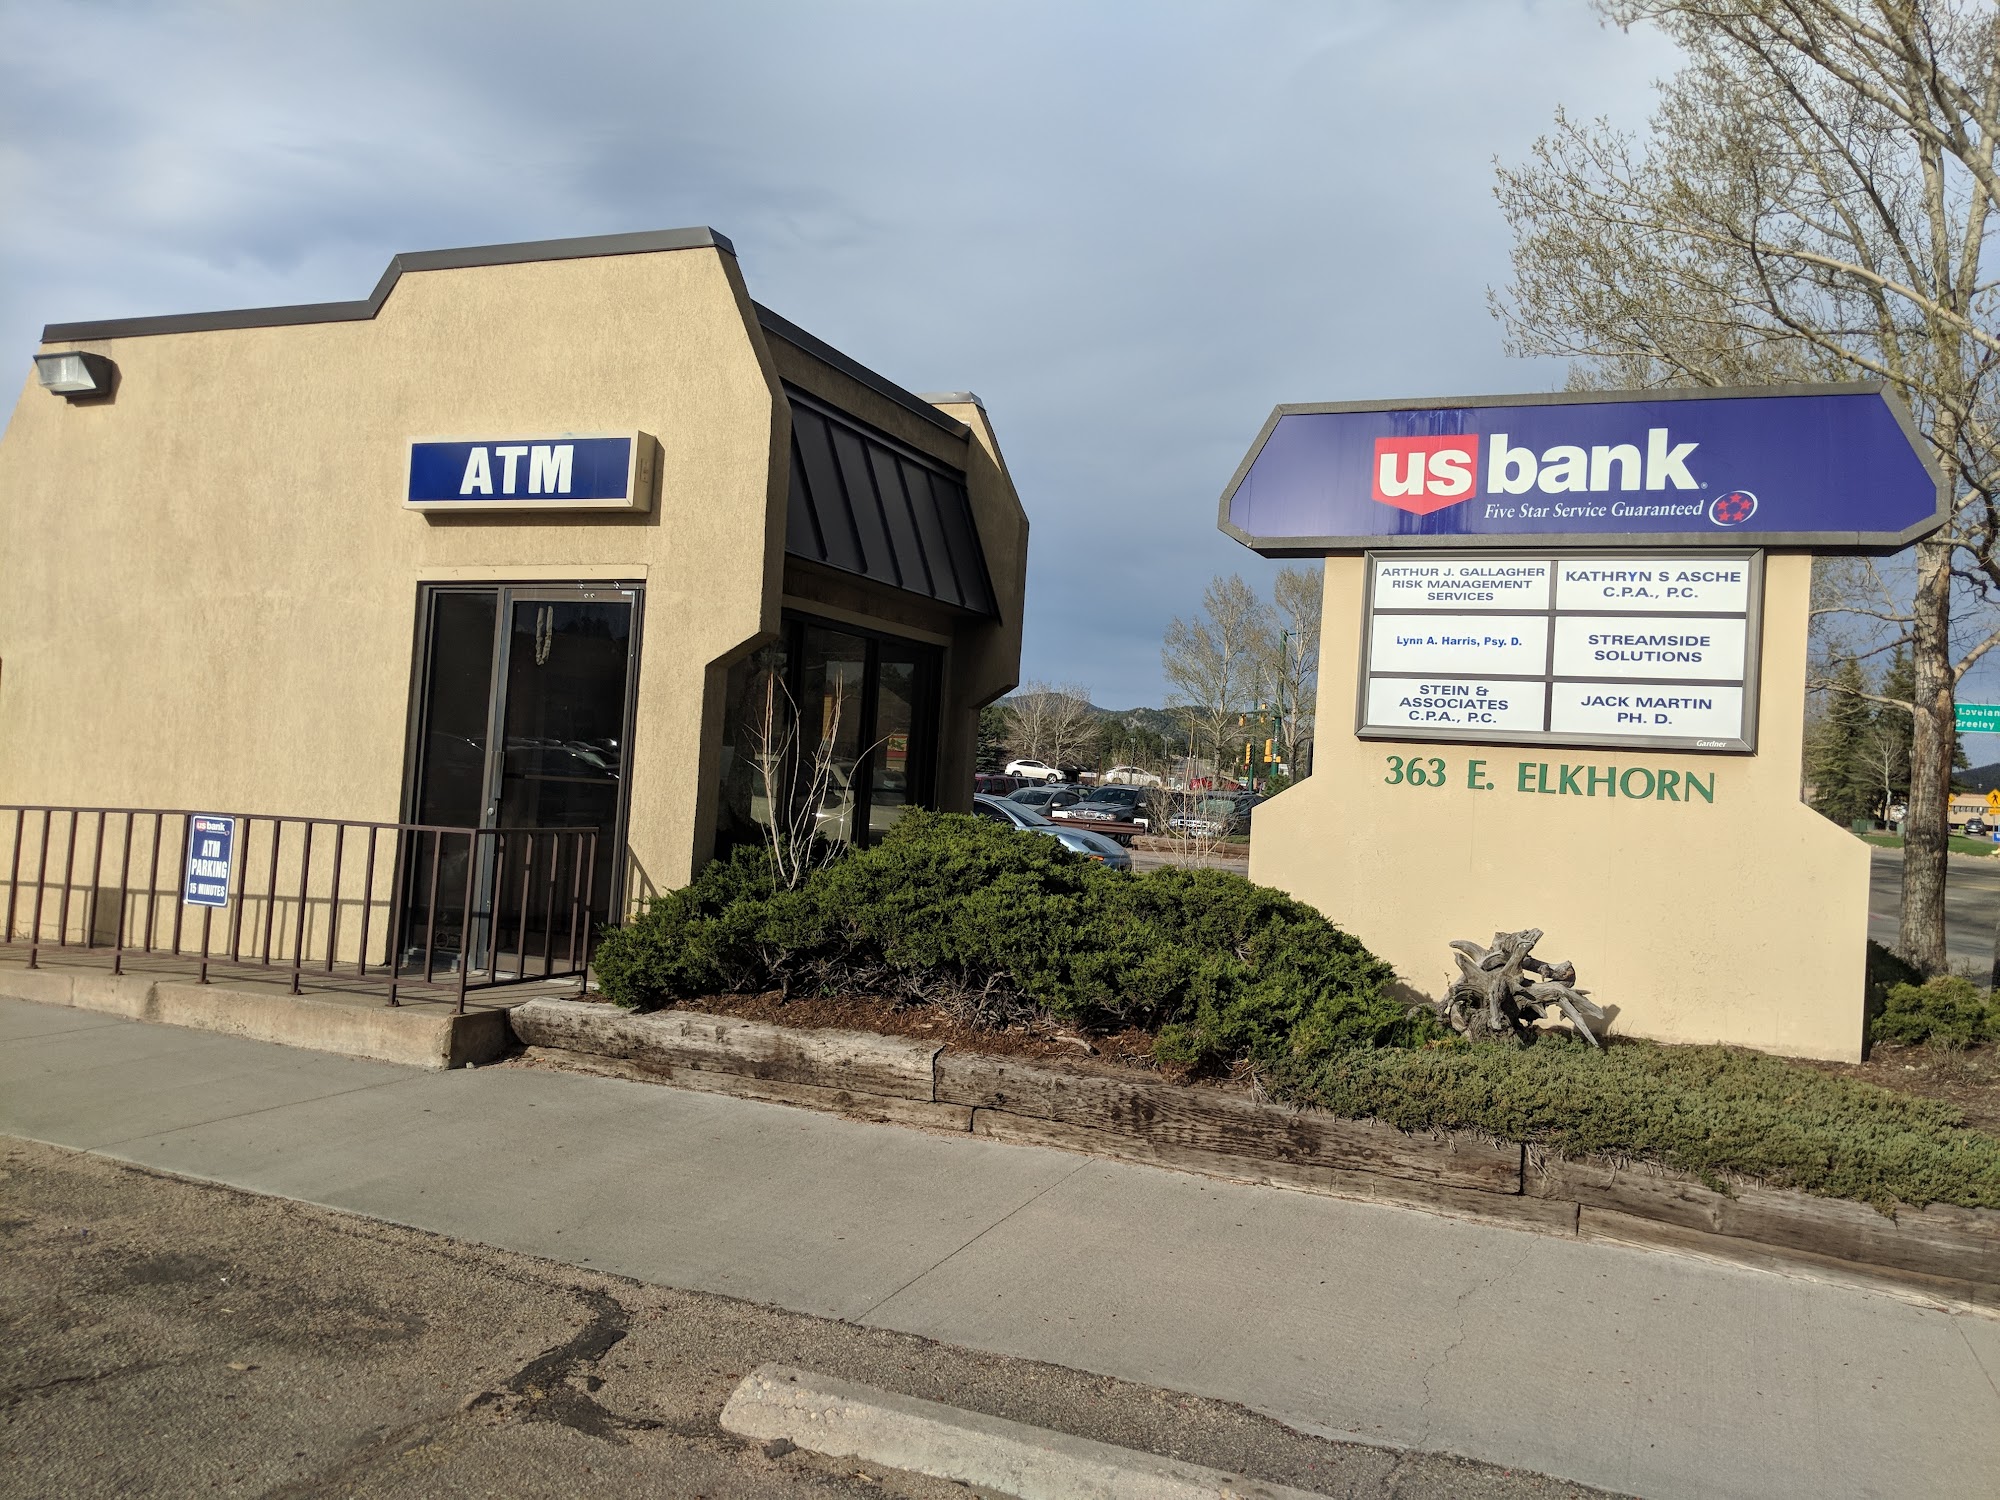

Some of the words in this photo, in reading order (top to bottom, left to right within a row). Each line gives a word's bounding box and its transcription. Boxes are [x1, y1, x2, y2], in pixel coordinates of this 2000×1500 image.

[1379, 449, 1473, 497] us
[1487, 428, 1700, 495] bank
[459, 444, 574, 495] ATM
[1484, 503, 1515, 518] Five
[1518, 502, 1551, 518] Star
[1553, 502, 1607, 517] Service
[1611, 499, 1704, 517] Guaranteed
[1381, 568, 1439, 577] ARTHUR
[1443, 568, 1454, 577] J.
[1459, 568, 1546, 577] GALLAGHER
[1565, 571, 1652, 582] KATHRYN
[1658, 571, 1670, 582] S
[1675, 571, 1741, 582] ASCHE
[1392, 580, 1424, 589] RISK
[1427, 580, 1533, 589] MANAGEMENT
[1427, 592, 1494, 601] SERVICES
[1603, 586, 1660, 600] C.P.A.,
[1666, 587, 1699, 599] P.C.
[1396, 635, 1423, 646] Lynn
[1426, 636, 1438, 645] A.
[1441, 637, 1480, 648] Harris,
[1484, 637, 1507, 648] Psy.
[1511, 637, 1522, 646] D.
[1588, 634, 1711, 647] STREAMSIDE
[1594, 650, 1703, 663] SOLUTIONS
[1419, 684, 1469, 696] STEIN
[1475, 686, 1490, 697] &
[1399, 697, 1509, 711] ASSOCIATES
[1581, 696, 1630, 708] JACK
[1635, 697, 1713, 710] MARTIN
[1408, 710, 1461, 724] C.P.A.,
[1467, 712, 1497, 724] P.C.
[1617, 712, 1647, 724] PH.
[1654, 713, 1673, 725] D.
[1955, 719, 1995, 730] Greeley
[1696, 739, 1727, 748] Gardner
[1384, 755, 1447, 788] 363
[1467, 759, 1495, 790] E.
[1517, 762, 1716, 803] ELKHORN
[207, 821, 225, 831] bank
[202, 840, 220, 857] ATM
[191, 859, 227, 878] PARKING
[190, 883, 197, 894] 15
[198, 884, 225, 896] MINUTES
